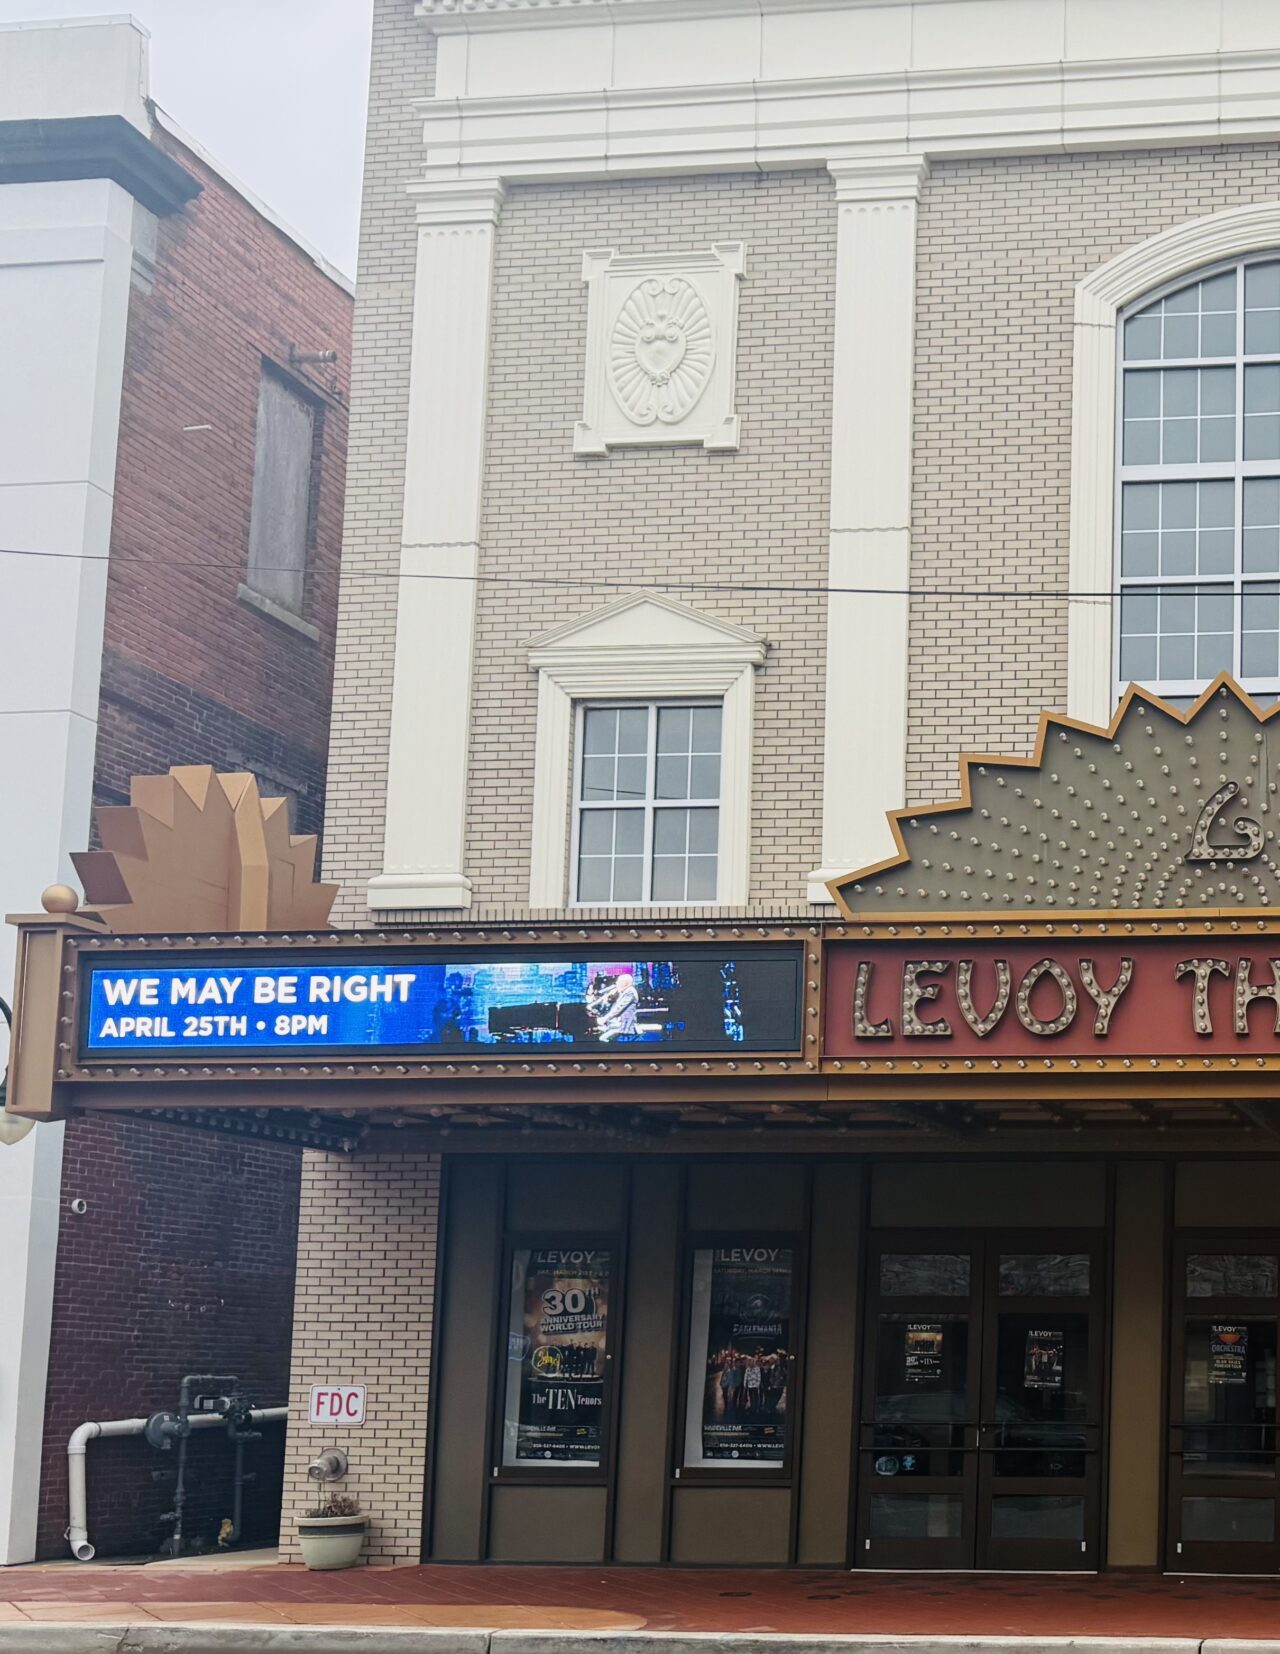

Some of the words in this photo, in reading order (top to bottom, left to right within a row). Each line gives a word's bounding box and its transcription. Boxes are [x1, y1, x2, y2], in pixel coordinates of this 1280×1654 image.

[103, 979, 160, 1006] WE
[170, 977, 243, 1005] MAY
[254, 976, 298, 1004] BE
[309, 974, 416, 1003] RIGHT
[855, 957, 1133, 1037] LEVOY
[99, 1017, 176, 1038] APRIL
[183, 1015, 247, 1037] 25TH
[274, 1014, 328, 1036] 8PM
[537, 1251, 596, 1264] LEVOY
[721, 1249, 780, 1262] LEVOY
[540, 1314, 605, 1325] ANNIVERSARY
[540, 1322, 575, 1332] WORLD
[577, 1320, 603, 1330] TOUR
[316, 1392, 359, 1417] FDC
[532, 1393, 547, 1405] The
[546, 1388, 577, 1410] TEN
[577, 1394, 603, 1406] Tenors
